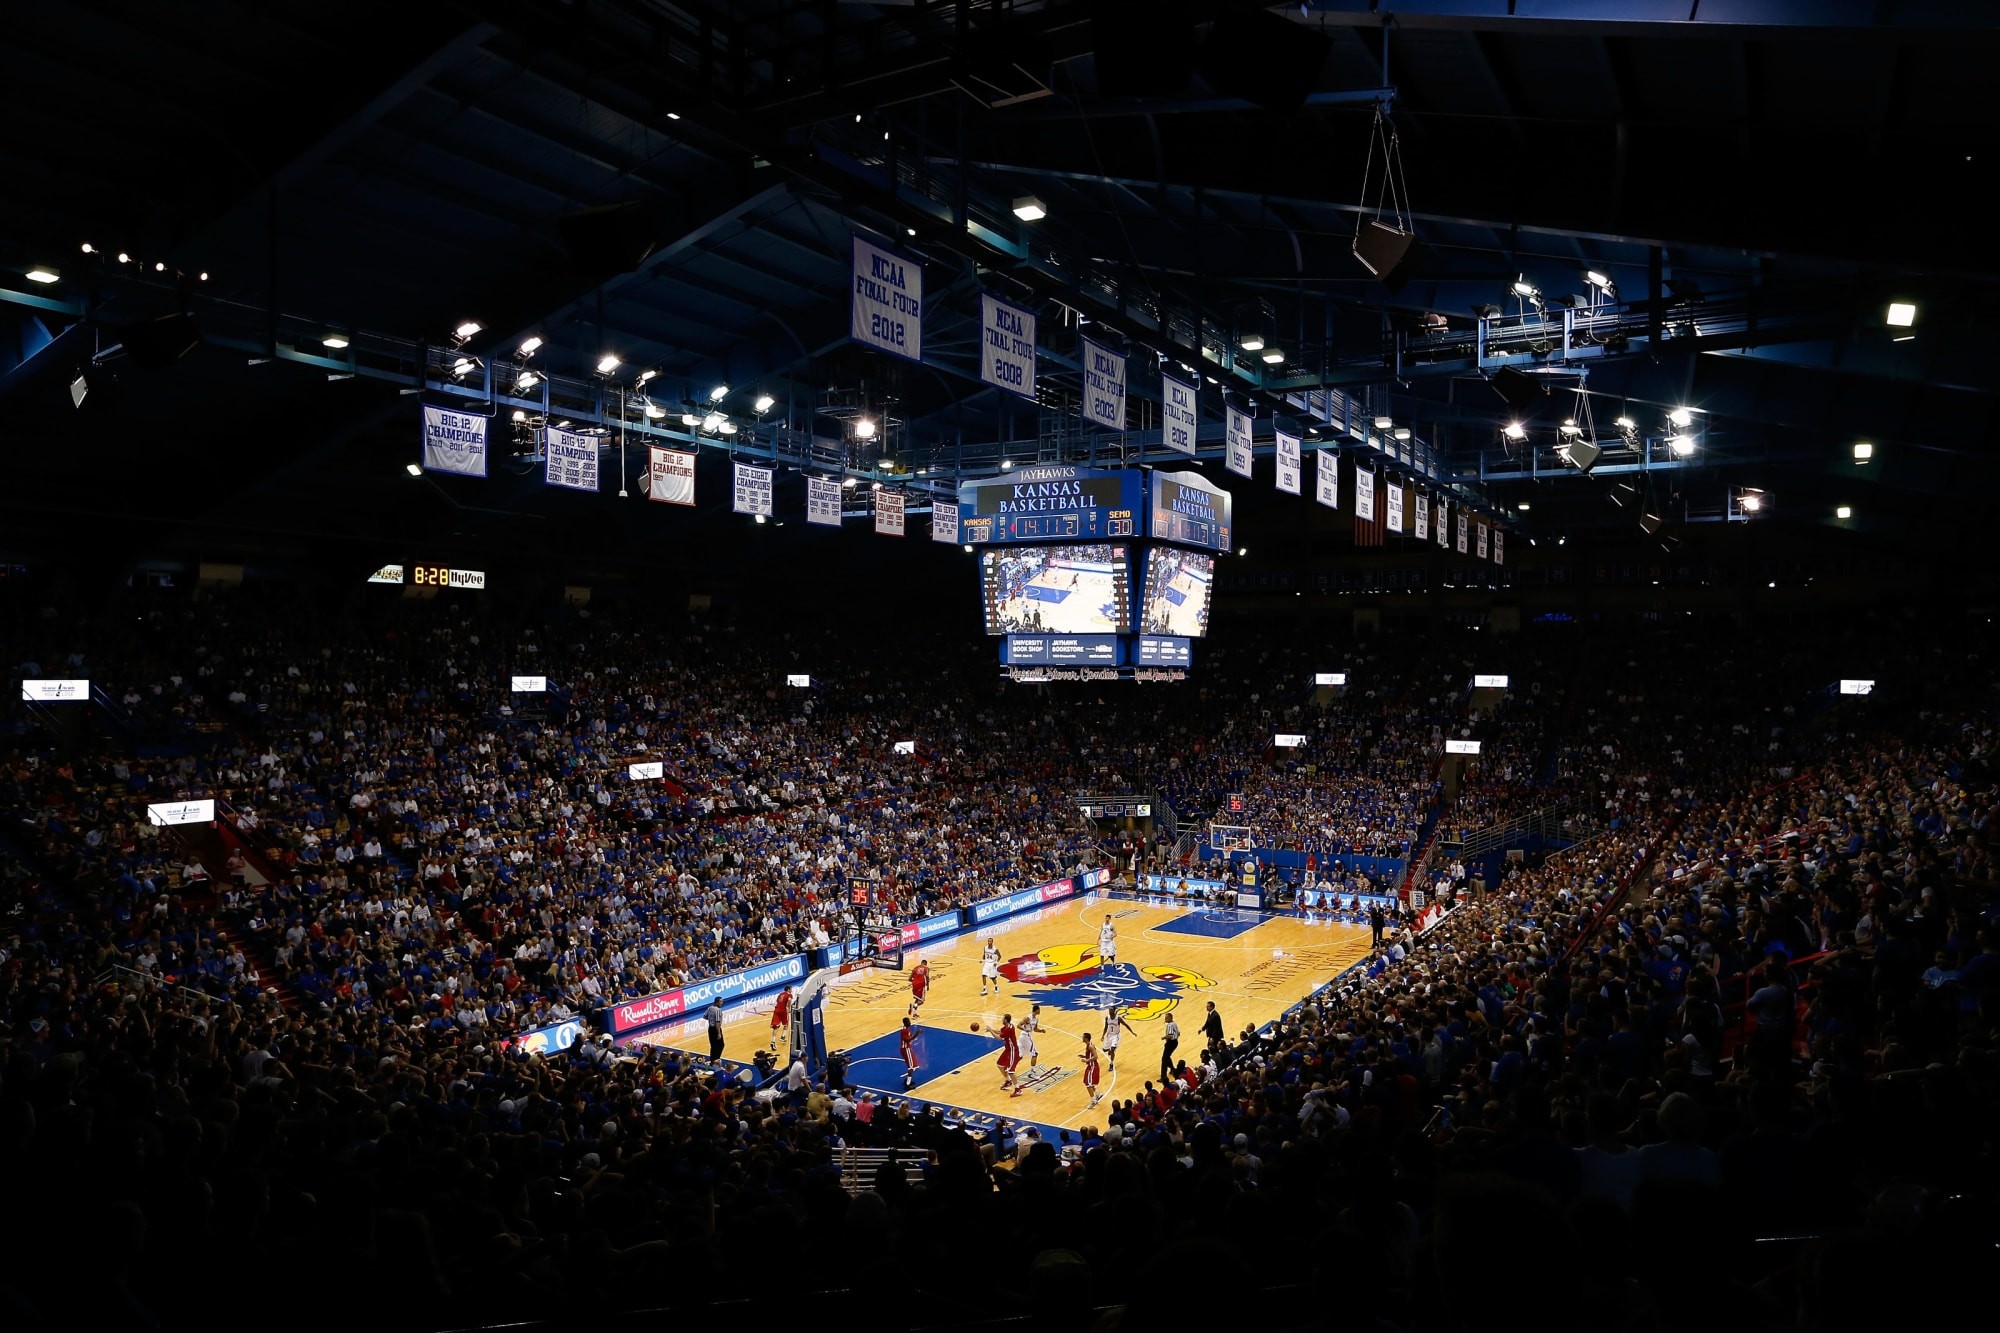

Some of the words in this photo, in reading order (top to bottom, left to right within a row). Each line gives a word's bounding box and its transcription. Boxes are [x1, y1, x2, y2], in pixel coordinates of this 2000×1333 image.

[872, 254, 905, 290] NCAA
[857, 275, 889, 306] FINAL
[893, 291, 919, 317] FOUR
[872, 313, 905, 347] 2012
[996, 307, 1023, 337] NCAA
[986, 326, 1010, 352] FINAL
[1012, 339, 1033, 360] FOUR
[996, 358, 1023, 386] 2008
[1095, 353, 1116, 378] NCAA
[1086, 370, 1105, 391] FINAL
[1107, 380, 1124, 397] FOUR
[1172, 386, 1188, 408] NCAA
[1095, 398, 1115, 420] 2003
[1165, 403, 1180, 420] FINAL
[1181, 410, 1195, 426] FOUR
[441, 413, 458, 427] BIG
[461, 417, 471, 430] 12
[428, 424, 483, 444] CHAMPIONS
[561, 434, 575, 447] BIG
[577, 438, 586, 449] 12
[1172, 427, 1188, 447] 2002
[449, 442, 463, 451] 2011
[1240, 435, 1252, 451] FOUR
[550, 443, 596, 462] CHAMPIONS
[662, 452, 675, 464] BIG
[676, 455, 684, 466] 12
[653, 462, 693, 478] CHAMPIONS
[739, 466, 750, 478] BIG
[751, 470, 769, 481] EIGHT
[1020, 467, 1076, 482] JAYHAWKS
[736, 476, 771, 491] CHAMPIONS
[811, 480, 821, 490] BIG
[1013, 481, 1081, 499] KANSAS
[810, 489, 840, 503] CHAMPIONS
[1179, 485, 1210, 506] KANSAS
[1000, 496, 1097, 513] BASKETBALL
[1172, 498, 1216, 521] BASKETBALL
[963, 517, 992, 527] KANSAS
[1108, 510, 1131, 519] SEMO
[1023, 519, 1060, 535] 14:11
[1066, 522, 1073, 535] 2
[1113, 520, 1130, 534] 30
[415, 566, 449, 586] 8:28
[450, 571, 483, 586] HyVee
[1008, 666, 1045, 683] Russell
[1080, 666, 1119, 682] Candies
[1230, 800, 1241, 810] 35
[853, 888, 867, 904] 35
[976, 906, 993, 919] ROCK
[993, 896, 1012, 911] CHALK
[741, 967, 788, 994] JAYHAWK!
[684, 987, 713, 1007] ROCK
[714, 973, 747, 994] CHALK
[621, 1002, 654, 1024] Russell
[652, 997, 680, 1014] Stover
[641, 1009, 678, 1024] CANDIES
